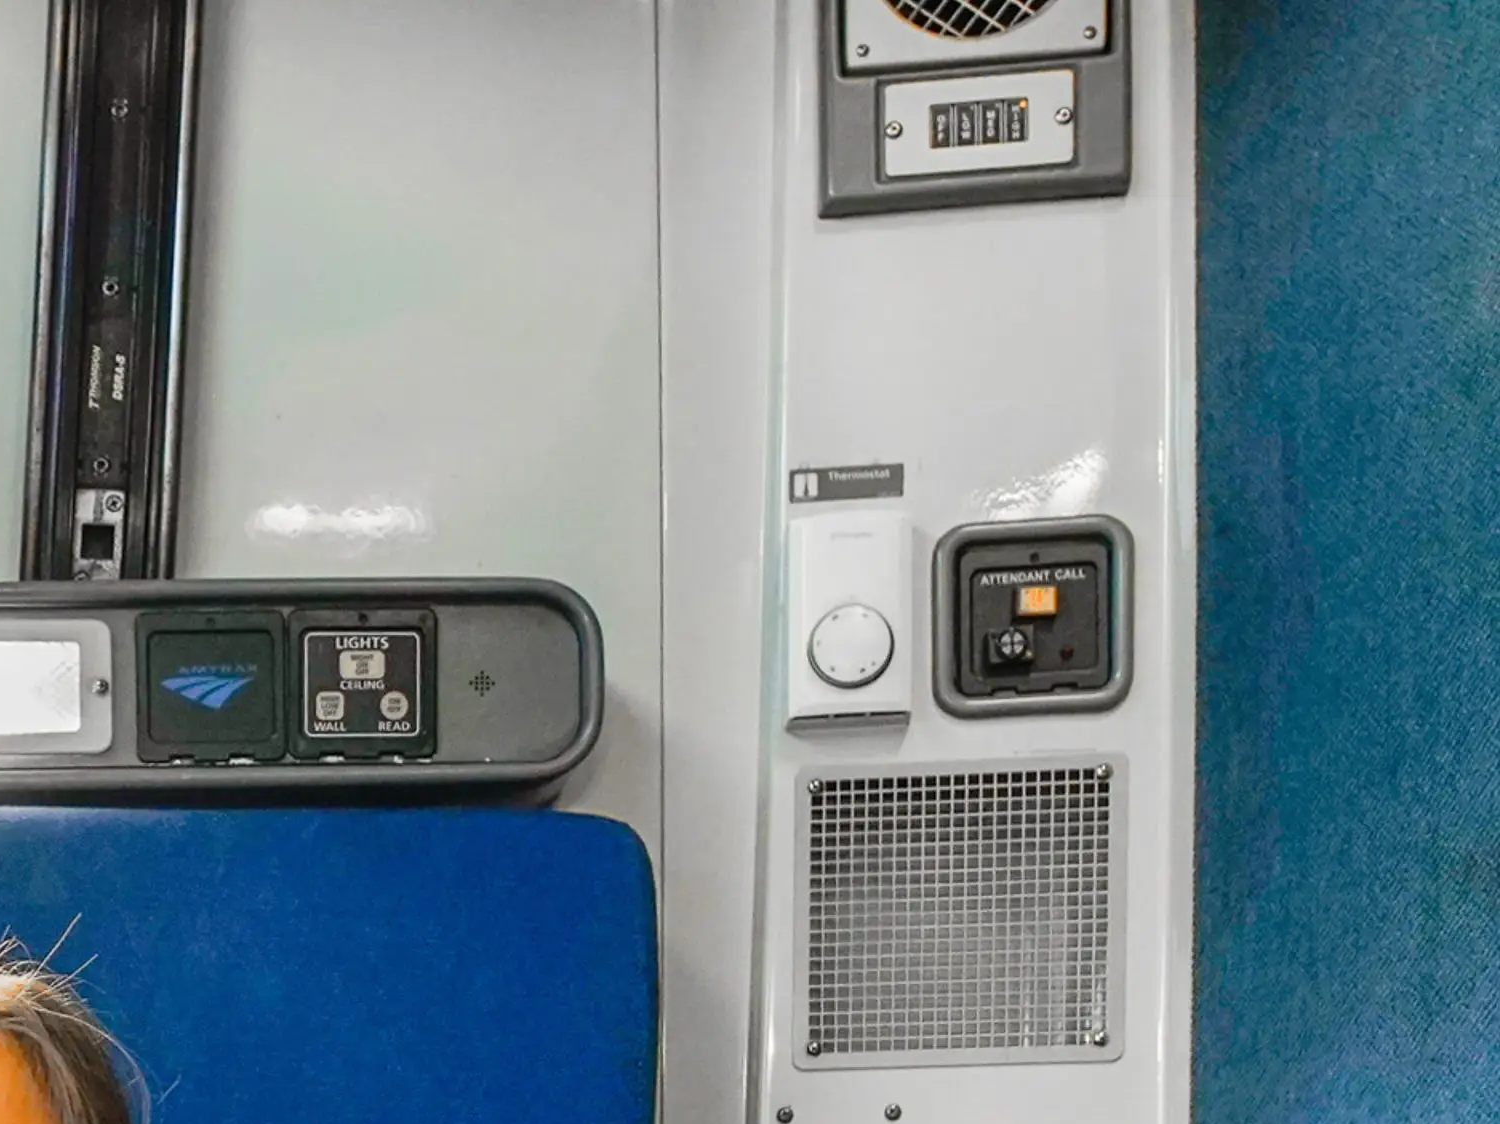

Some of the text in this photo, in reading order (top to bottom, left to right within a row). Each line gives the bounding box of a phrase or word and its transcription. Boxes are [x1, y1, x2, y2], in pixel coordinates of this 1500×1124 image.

[828, 468, 891, 481] Thermostat
[980, 567, 1087, 586] ATTENDANT CALL
[335, 636, 390, 650] LIGHTS
[339, 680, 386, 690] CEILING
[313, 721, 347, 732] WALL
[378, 720, 411, 731] READ
